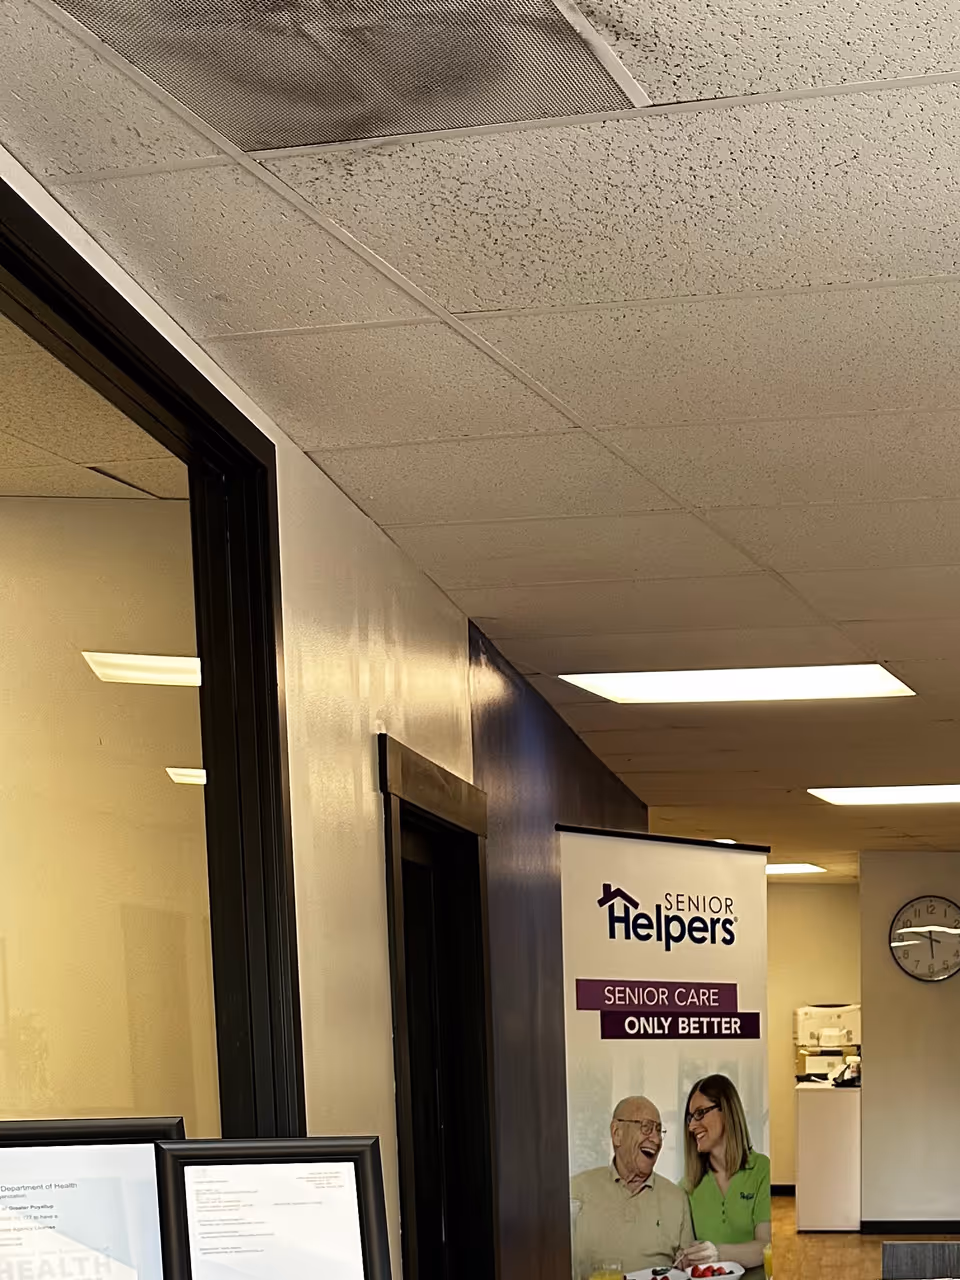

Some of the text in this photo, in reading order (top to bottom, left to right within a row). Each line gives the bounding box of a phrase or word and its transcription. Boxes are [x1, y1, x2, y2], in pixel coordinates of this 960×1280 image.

[664, 892, 734, 915] SENIOR
[926, 904, 936, 915] 12
[914, 908, 921, 918] 11
[607, 900, 736, 952] Helpers
[902, 950, 910, 960] 8
[604, 986, 720, 1007] SENIOR CARE
[624, 1016, 741, 1034] ONLY BETTER
[0, 1184, 44, 1193] Department
